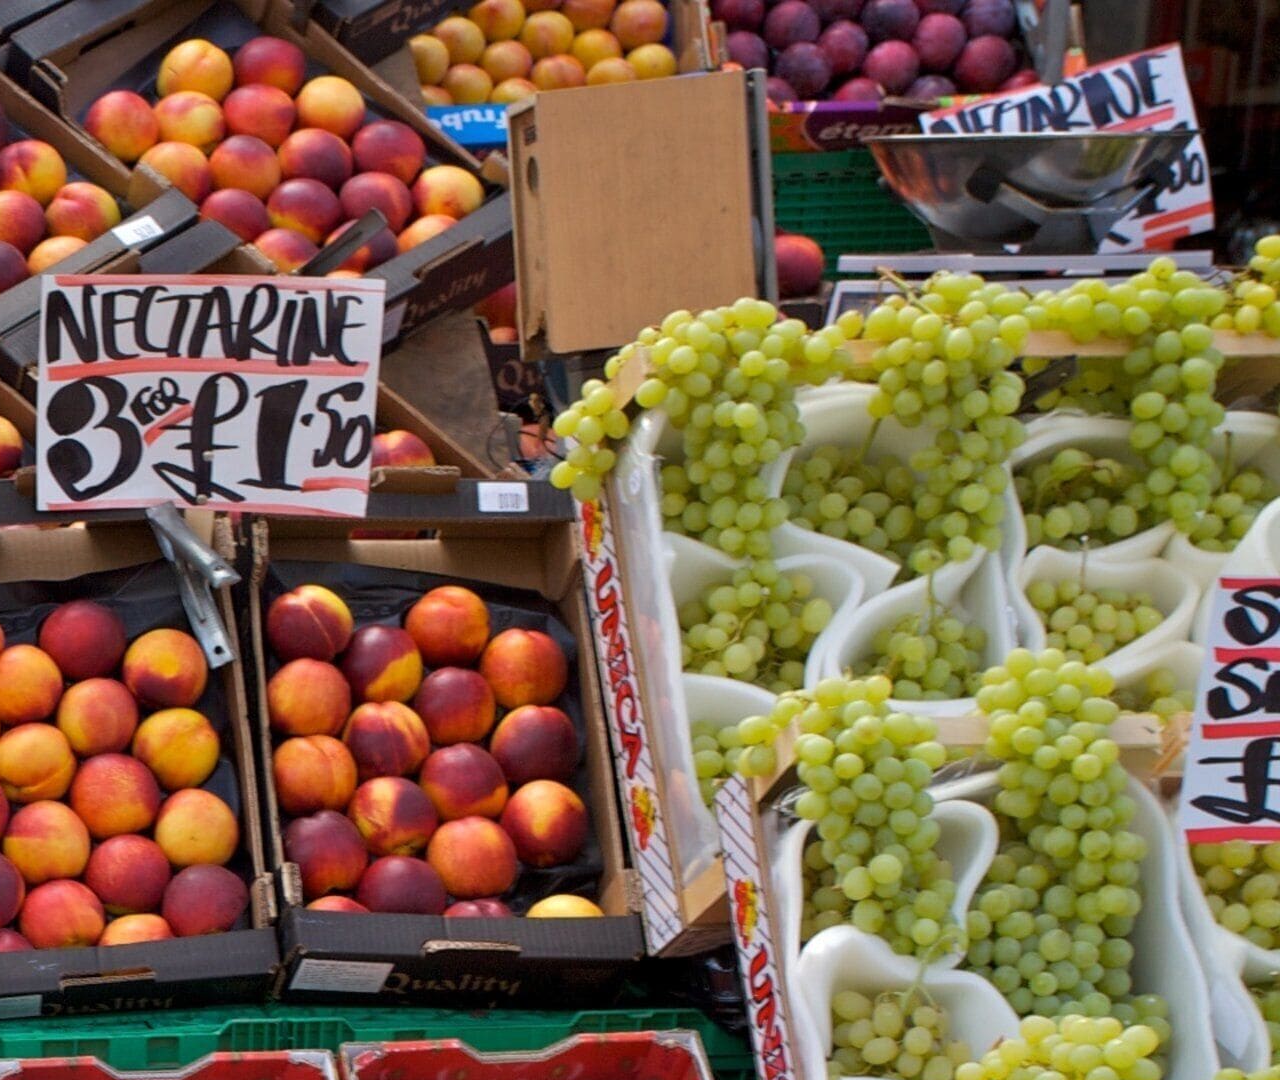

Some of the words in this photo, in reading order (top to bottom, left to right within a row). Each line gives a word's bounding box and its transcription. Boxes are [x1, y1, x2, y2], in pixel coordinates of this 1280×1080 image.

[45, 282, 367, 367] NECTARINE
[46, 375, 144, 502] 3
[130, 376, 191, 425] FOR
